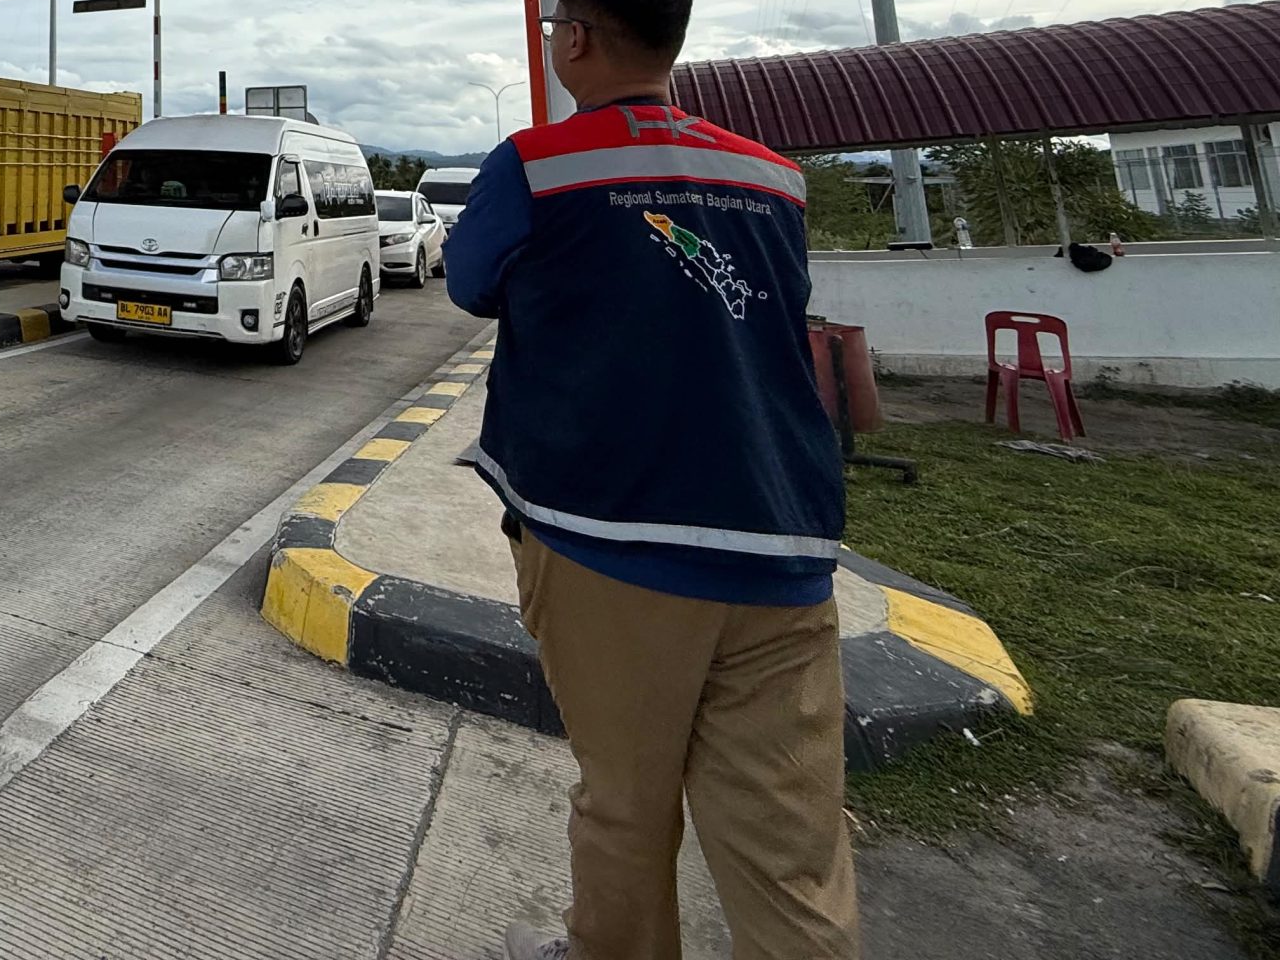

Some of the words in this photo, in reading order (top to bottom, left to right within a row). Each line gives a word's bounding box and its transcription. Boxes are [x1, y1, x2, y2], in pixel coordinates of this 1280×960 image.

[617, 106, 717, 143] HK
[609, 191, 653, 208] Regional
[655, 191, 704, 205] Sumatera
[706, 193, 743, 212] Bagian
[745, 198, 772, 215] Utara
[120, 303, 130, 313] BL
[134, 304, 154, 315] 7903
[157, 307, 168, 318] AA
